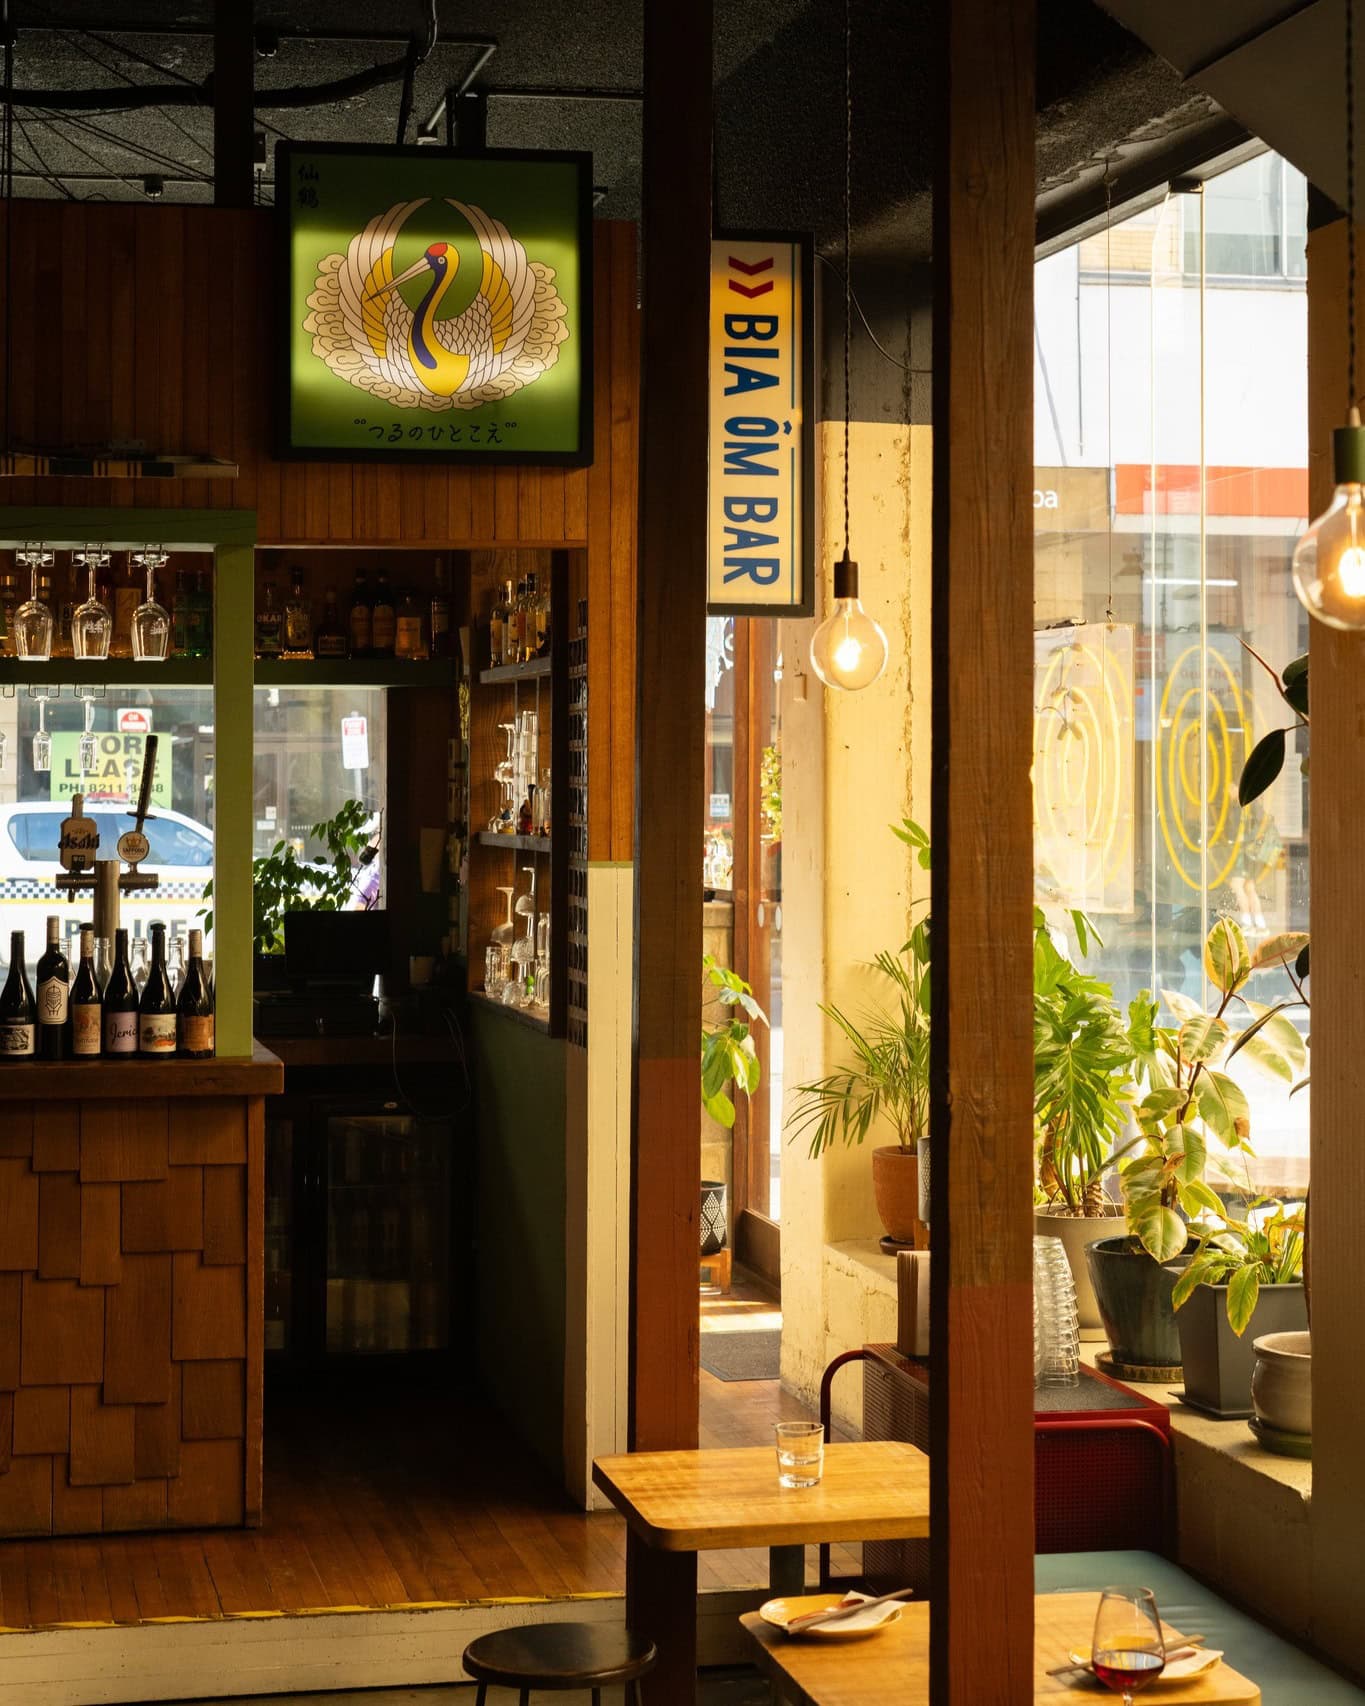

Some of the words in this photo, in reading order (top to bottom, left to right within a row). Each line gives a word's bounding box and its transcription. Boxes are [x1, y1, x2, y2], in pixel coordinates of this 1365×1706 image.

[723, 313, 780, 397] BIA
[723, 416, 793, 476] ÔM
[723, 496, 780, 586] BAR
[83, 735, 142, 755] OR
[89, 783, 123, 793] 8211
[58, 832, 100, 850] Asahi
